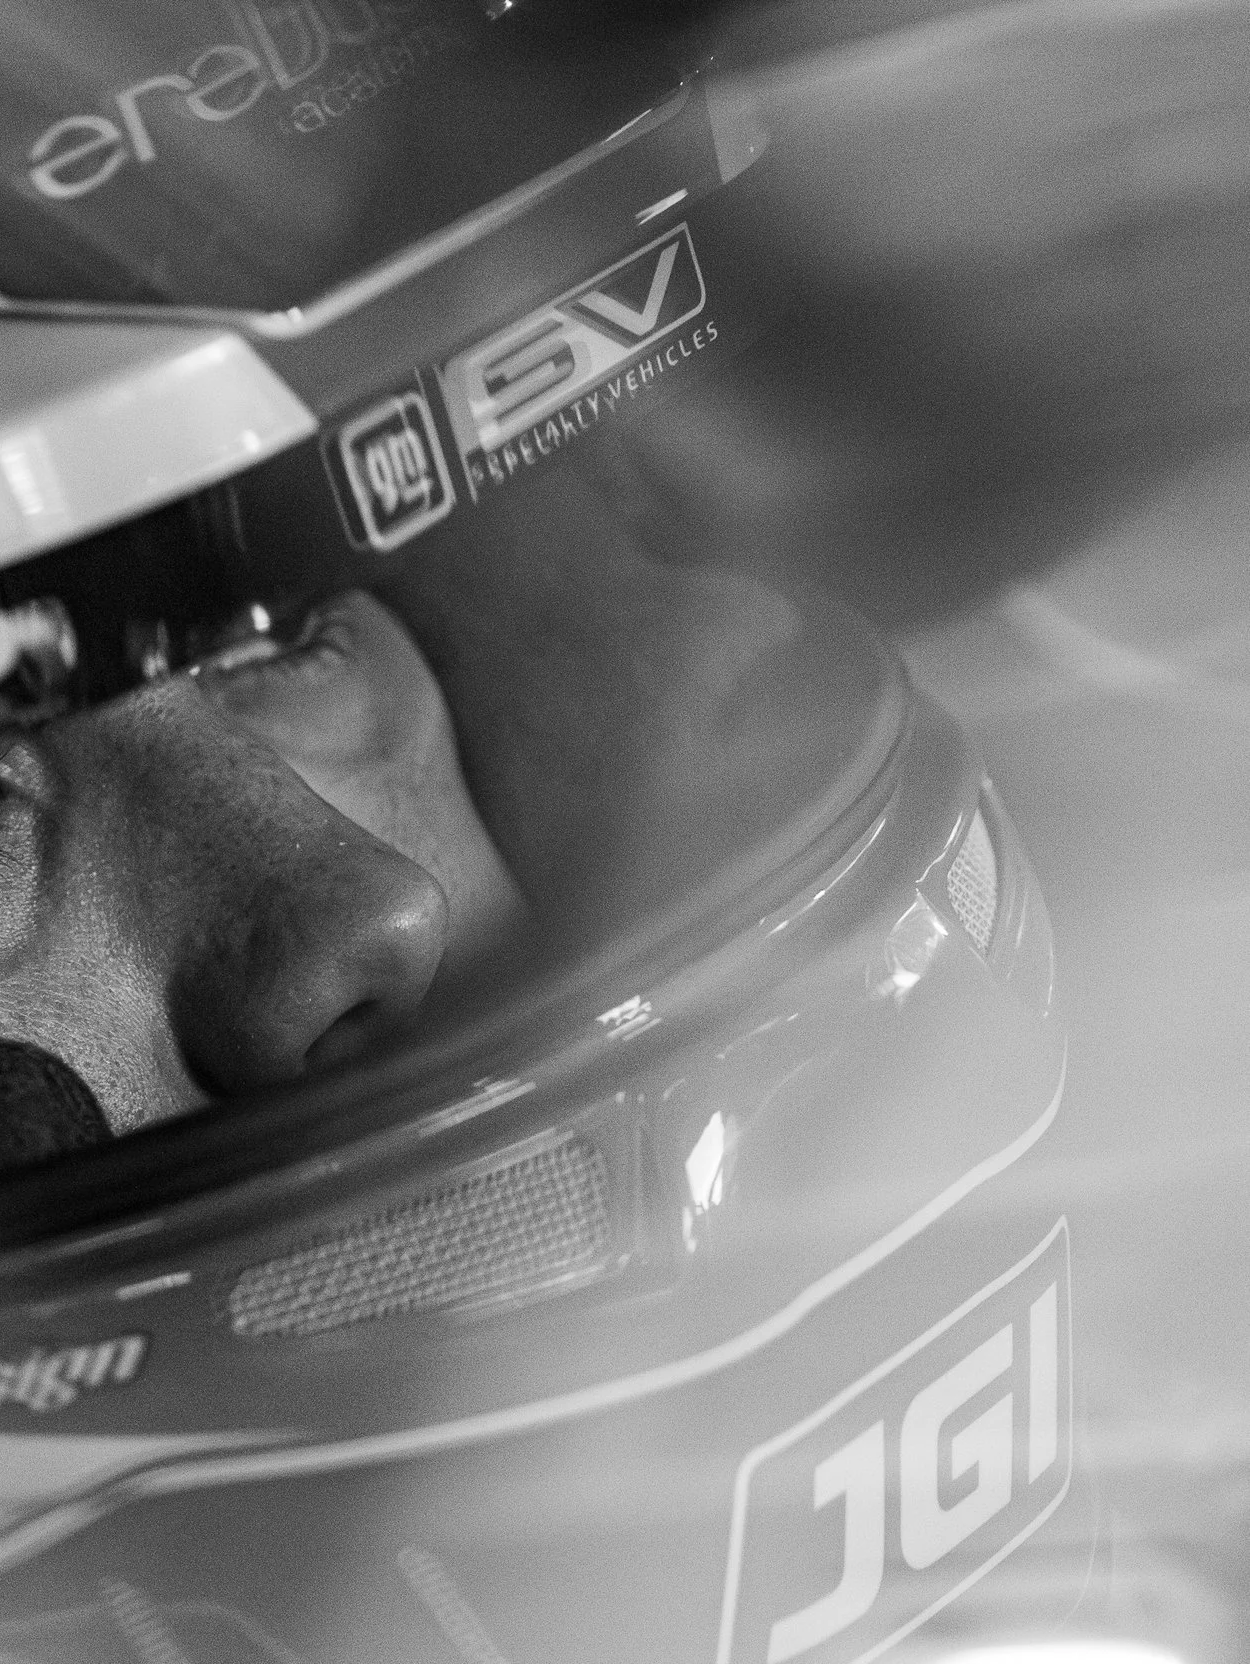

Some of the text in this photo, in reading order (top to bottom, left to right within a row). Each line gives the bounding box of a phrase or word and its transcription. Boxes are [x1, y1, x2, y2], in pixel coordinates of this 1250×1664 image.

[27, 0, 416, 200] erebu
[607, 320, 720, 399] VEHICLES
[767, 1280, 1058, 1664] JGI
